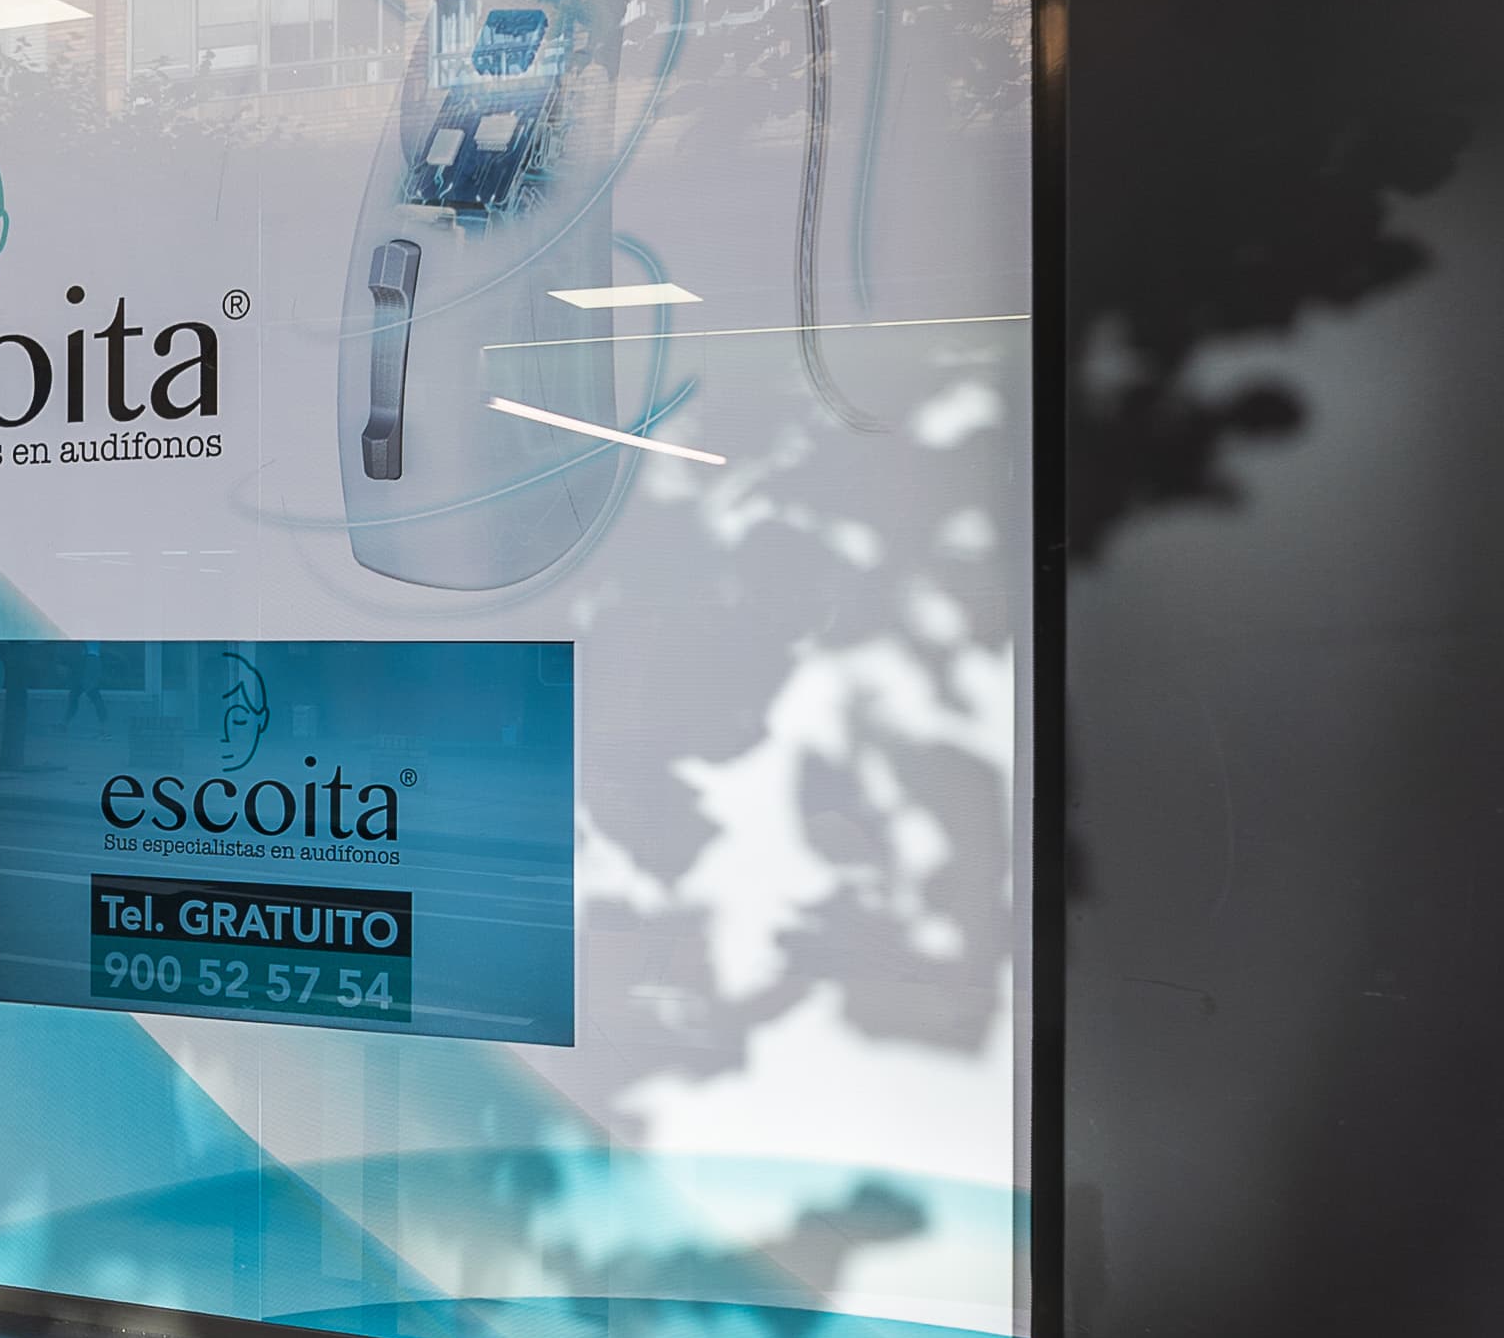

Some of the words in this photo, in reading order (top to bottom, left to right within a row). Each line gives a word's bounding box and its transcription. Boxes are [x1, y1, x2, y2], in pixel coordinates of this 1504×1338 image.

[11, 440, 52, 466] en
[59, 431, 223, 463] audífonos
[100, 755, 399, 841] escoita
[103, 833, 138, 851] Sus
[142, 837, 266, 859] especialistas
[271, 844, 296, 860] en
[300, 844, 401, 865] audífonos
[100, 894, 165, 933] Tel.
[178, 899, 399, 949] GRATUITO
[103, 951, 182, 993] 900
[197, 959, 249, 999] 52
[264, 964, 321, 1004] 57
[336, 968, 393, 1011] 54
